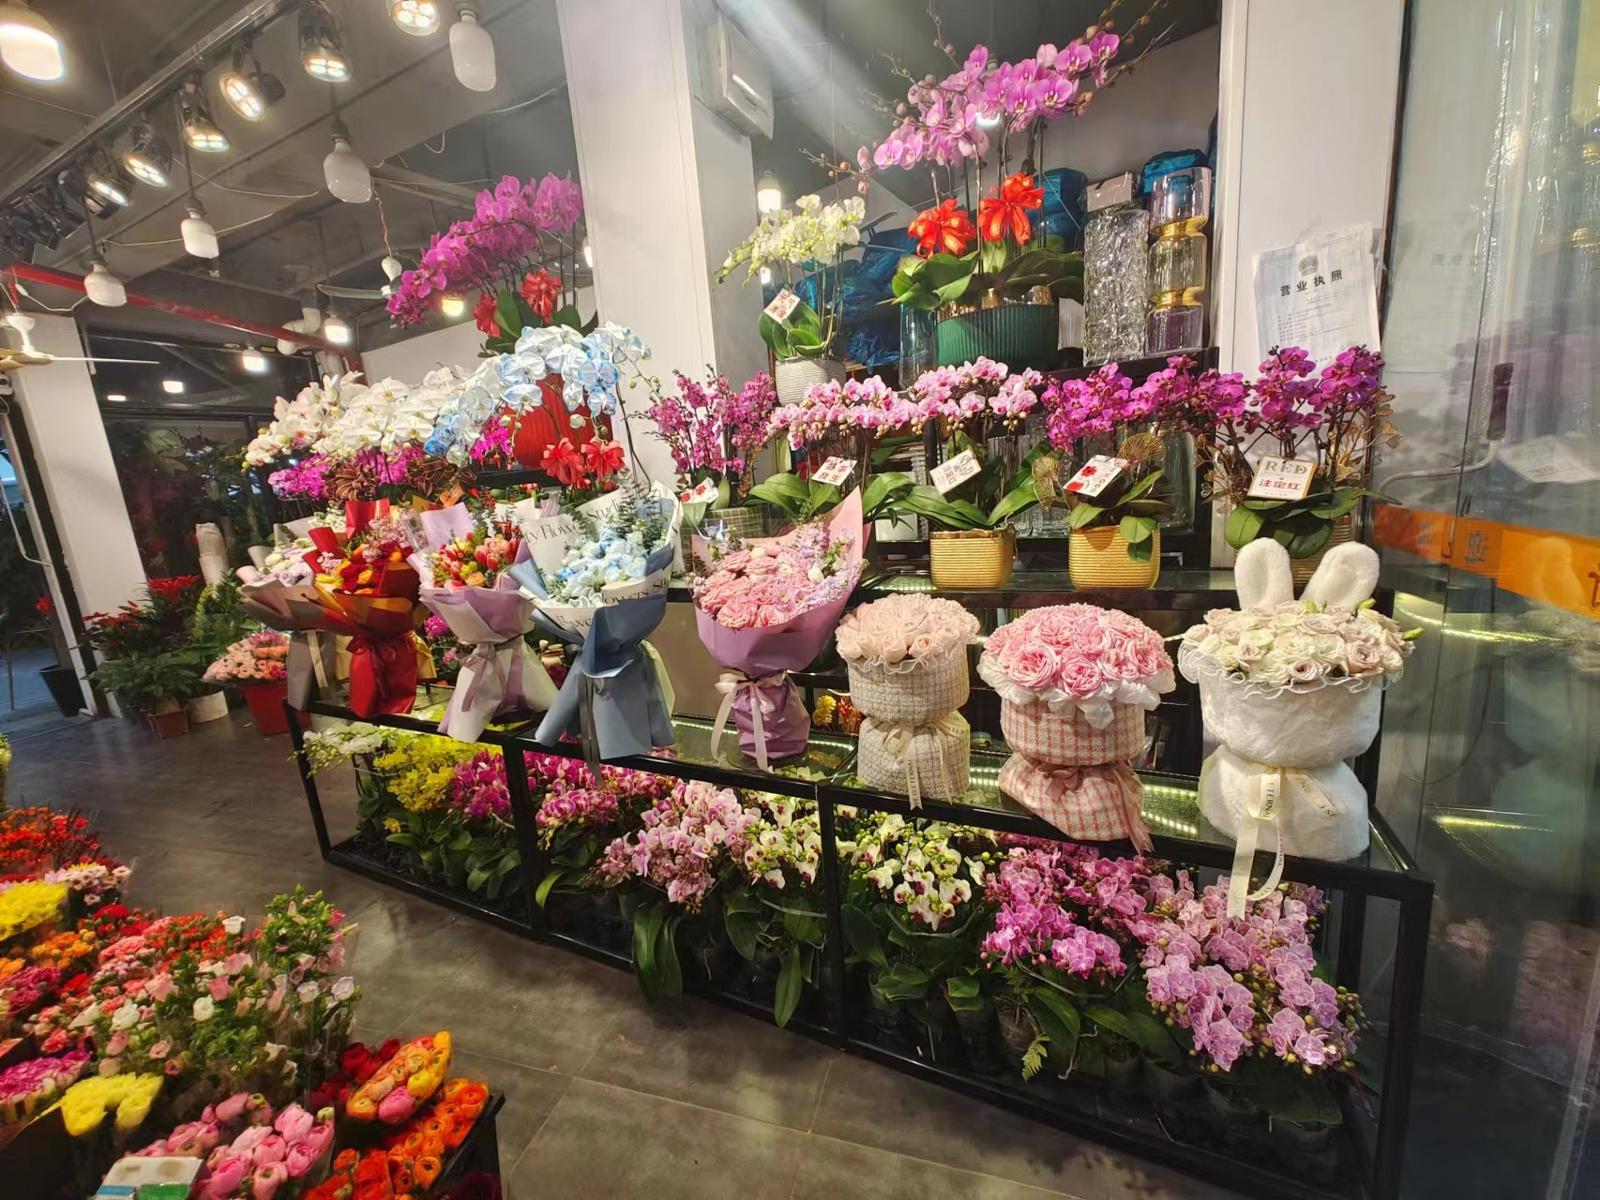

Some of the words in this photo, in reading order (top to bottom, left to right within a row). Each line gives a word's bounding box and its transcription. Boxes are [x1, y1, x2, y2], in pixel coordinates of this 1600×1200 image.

[1280, 269, 1343, 297] 营业执照
[1264, 460, 1308, 475] RED
